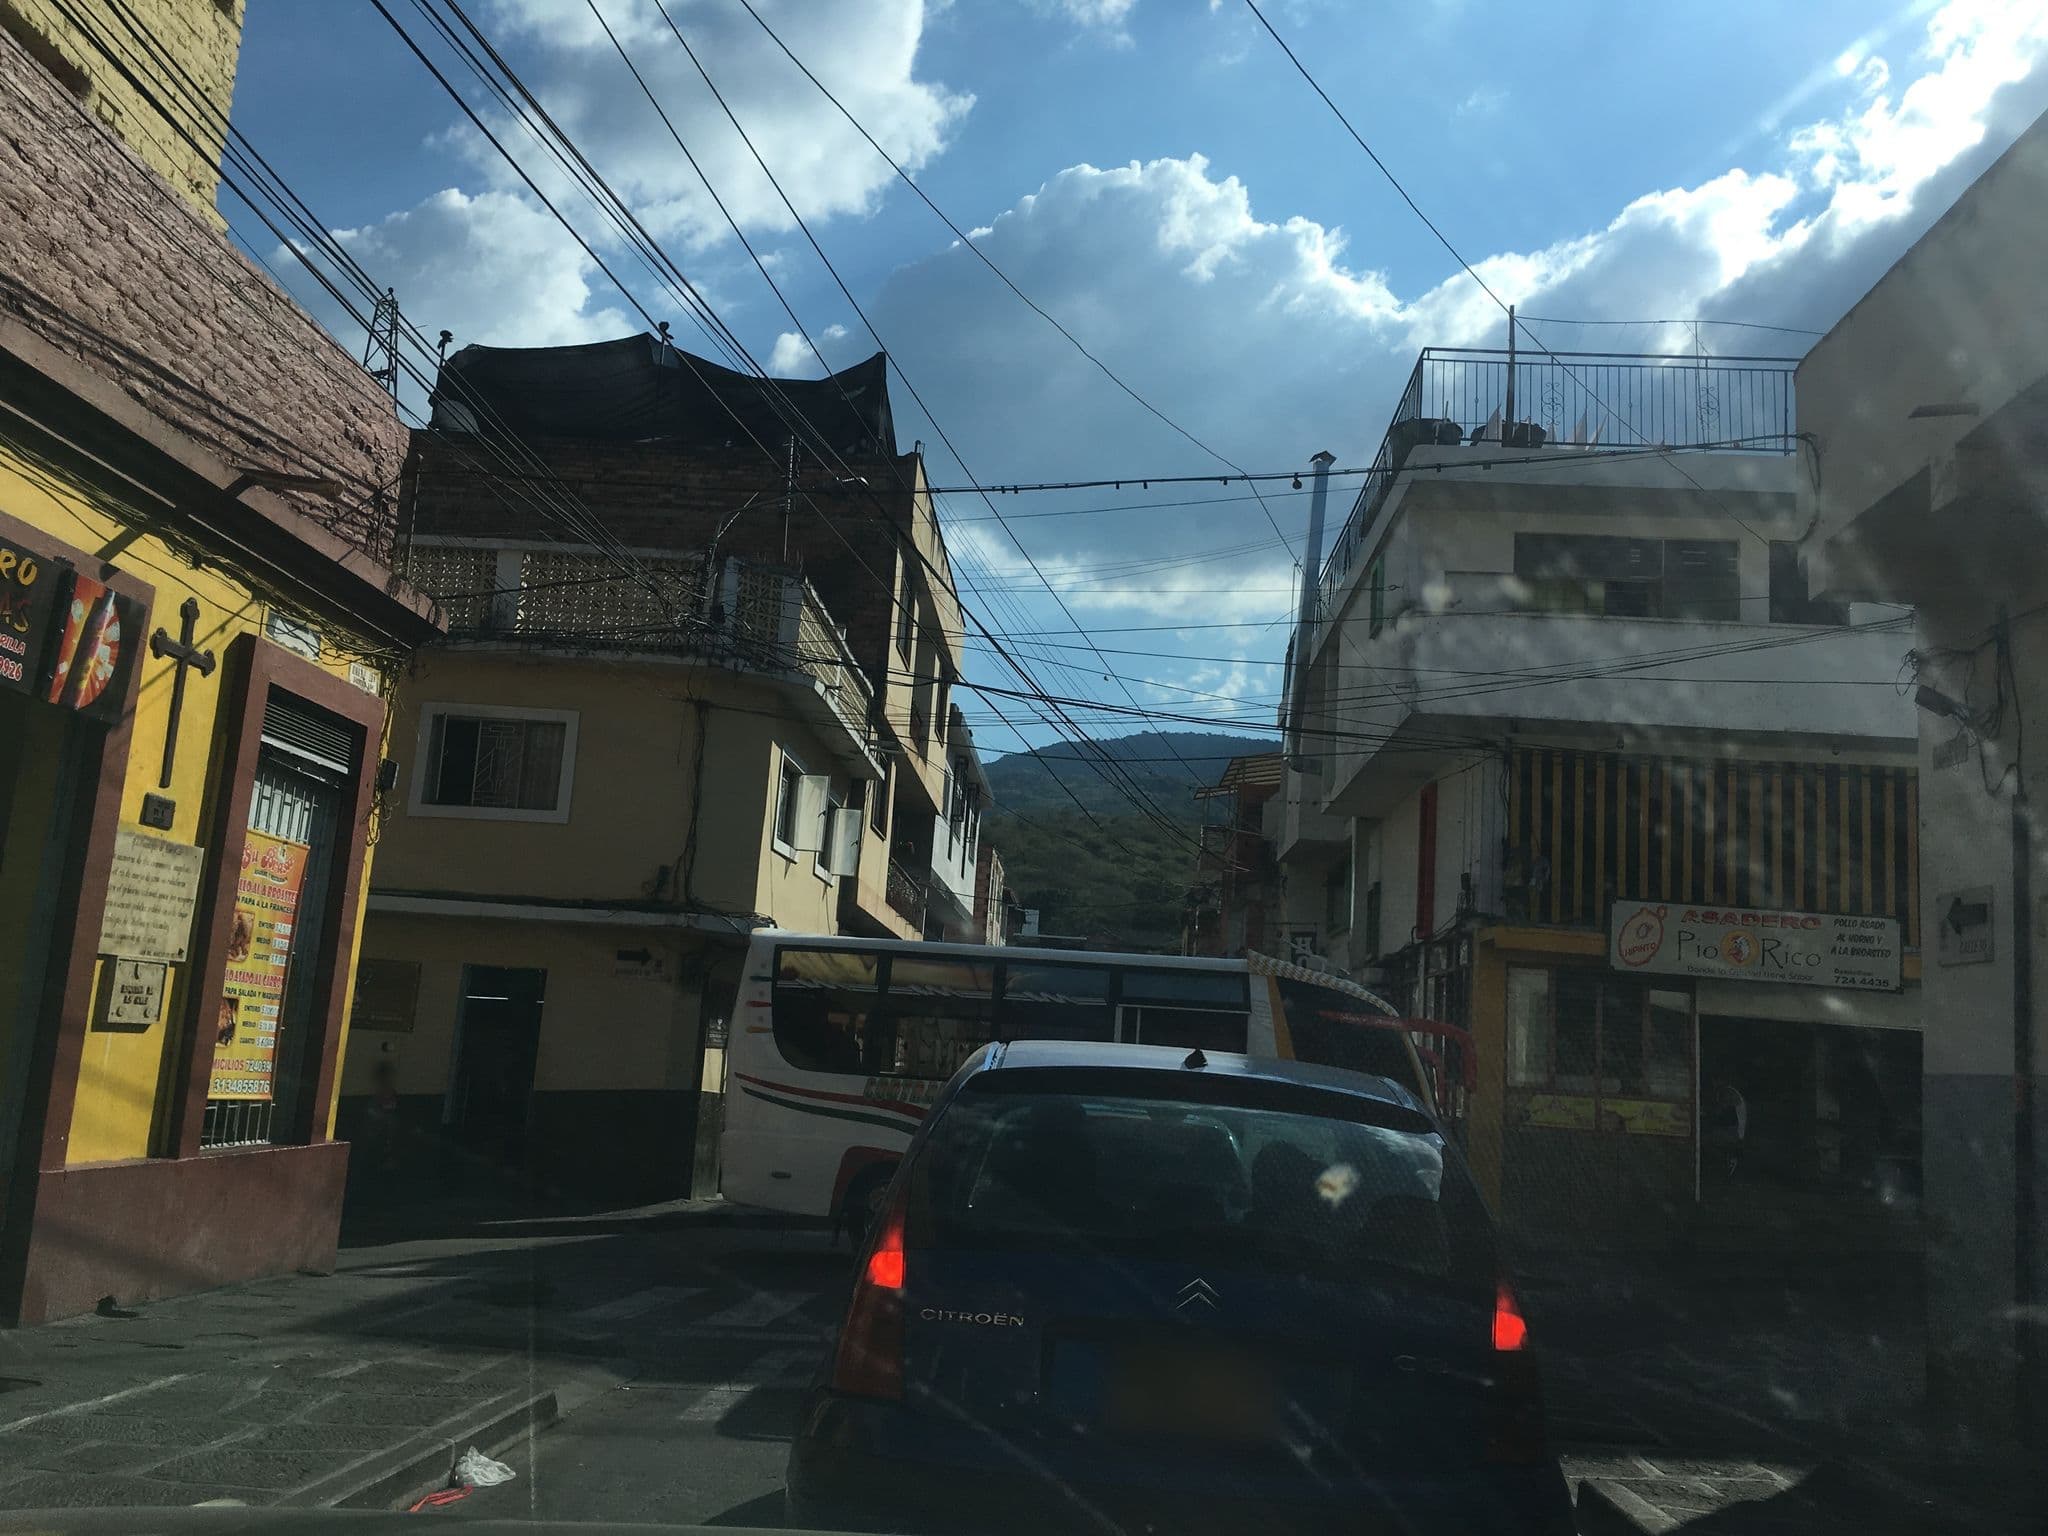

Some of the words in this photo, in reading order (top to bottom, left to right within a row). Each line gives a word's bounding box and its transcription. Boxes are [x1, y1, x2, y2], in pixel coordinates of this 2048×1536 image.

[1679, 909, 1822, 931] ASADERO
[1834, 918, 1858, 929] POLLO
[1761, 937, 1821, 969] Rico
[1834, 975, 1857, 985] 724
[1860, 977, 1889, 988] 4435
[920, 1308, 1024, 1327] CITROËN
